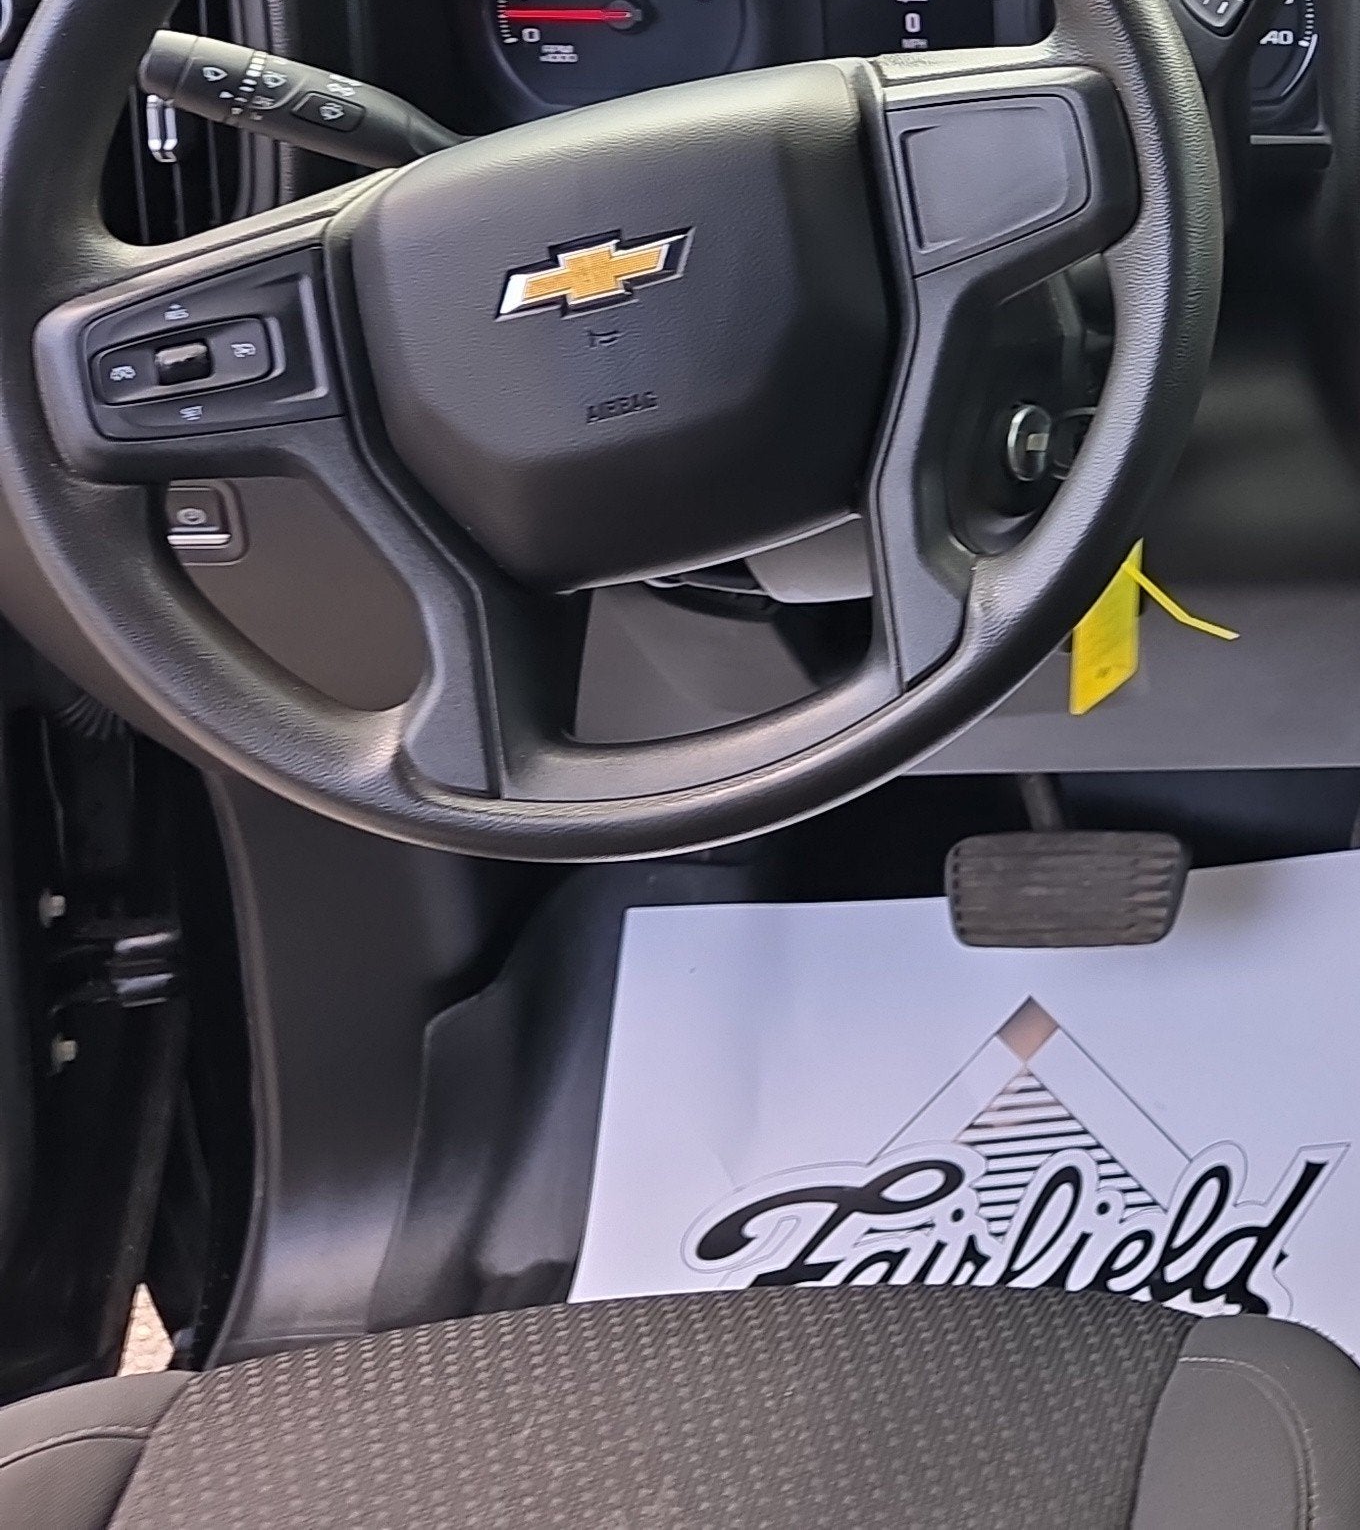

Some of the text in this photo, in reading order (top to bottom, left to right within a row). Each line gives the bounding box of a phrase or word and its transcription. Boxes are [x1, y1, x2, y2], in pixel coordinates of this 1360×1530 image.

[904, 12, 922, 33] 0
[521, 26, 542, 43] 0
[695, 1159, 1328, 1316] Fairfield
